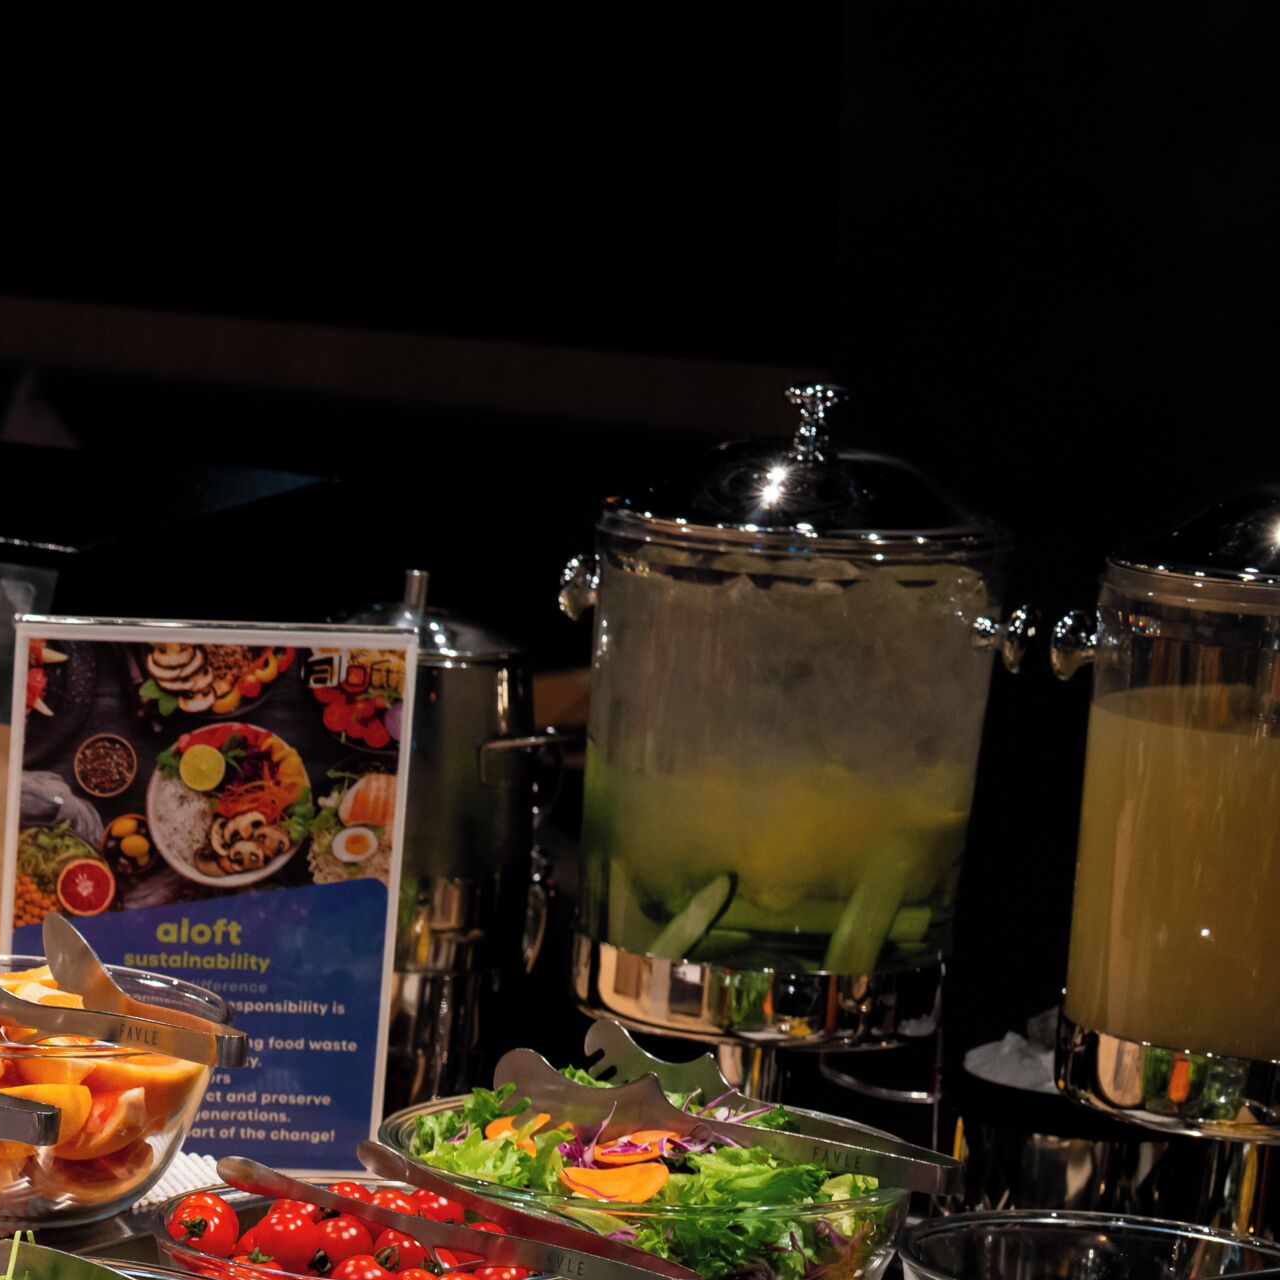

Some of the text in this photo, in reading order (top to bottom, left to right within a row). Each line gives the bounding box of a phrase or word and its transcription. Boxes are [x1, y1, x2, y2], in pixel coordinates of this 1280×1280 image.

[156, 917, 243, 946] aloft
[123, 951, 271, 974] sustainability
[332, 1001, 345, 1015] is
[268, 1036, 305, 1050] food
[308, 1039, 358, 1052] waste
[226, 1090, 257, 1103] and
[260, 1093, 332, 1106] preserve
[219, 1126, 236, 1139] of
[239, 1127, 266, 1140] the
[270, 1128, 336, 1144] change!
